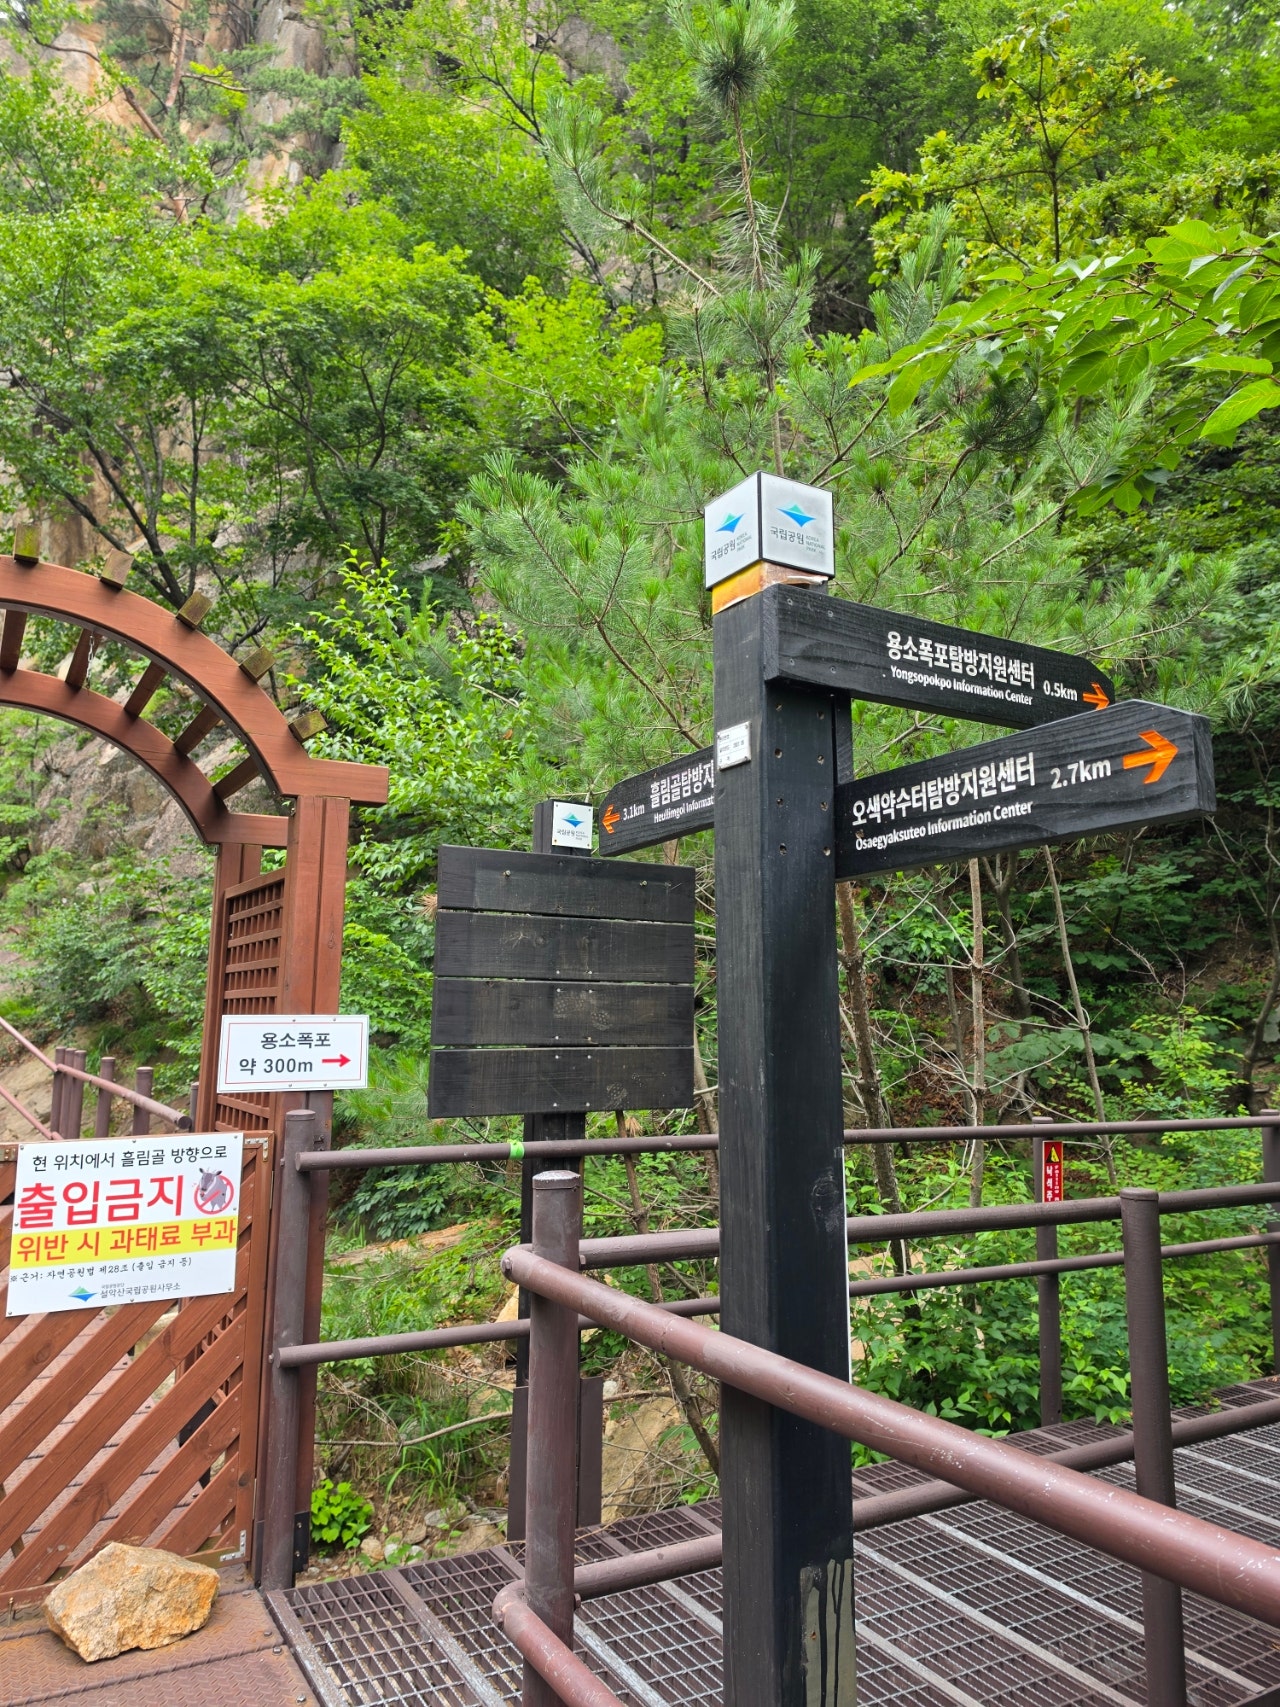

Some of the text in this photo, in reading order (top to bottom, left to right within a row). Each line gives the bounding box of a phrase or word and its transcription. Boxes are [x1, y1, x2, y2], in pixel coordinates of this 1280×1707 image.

[770, 526, 804, 545] 국립공원
[711, 539, 736, 560] 국립공원
[886, 630, 1035, 690] 용소폭포탐방지원센터
[890, 665, 1033, 706] Yongsopokpo Information Center
[1043, 680, 1078, 702] 0.5km
[1050, 757, 1112, 790] 2.7km
[852, 752, 1036, 827] 오색약수터탐방지원센터
[622, 804, 645, 821] 3.1km
[654, 803, 686, 824] Heullimgol
[855, 802, 1034, 851] Osaegyaksuteo Information Center
[260, 1032, 331, 1050] 용소폭포
[239, 1058, 313, 1076] 약 300m
[33, 1145, 228, 1172] 현 위치에서 흘림골 방향으로
[17, 1175, 184, 1230] 출입금지
[17, 1219, 236, 1263] 위반 시 과태료 부과
[20, 1272, 43, 1283] 근거:
[47, 1266, 95, 1280] 자연공원법
[99, 1265, 129, 1275] 제28조
[157, 1258, 175, 1269] 금지
[100, 1282, 182, 1299] 설악산국립공원사무소
